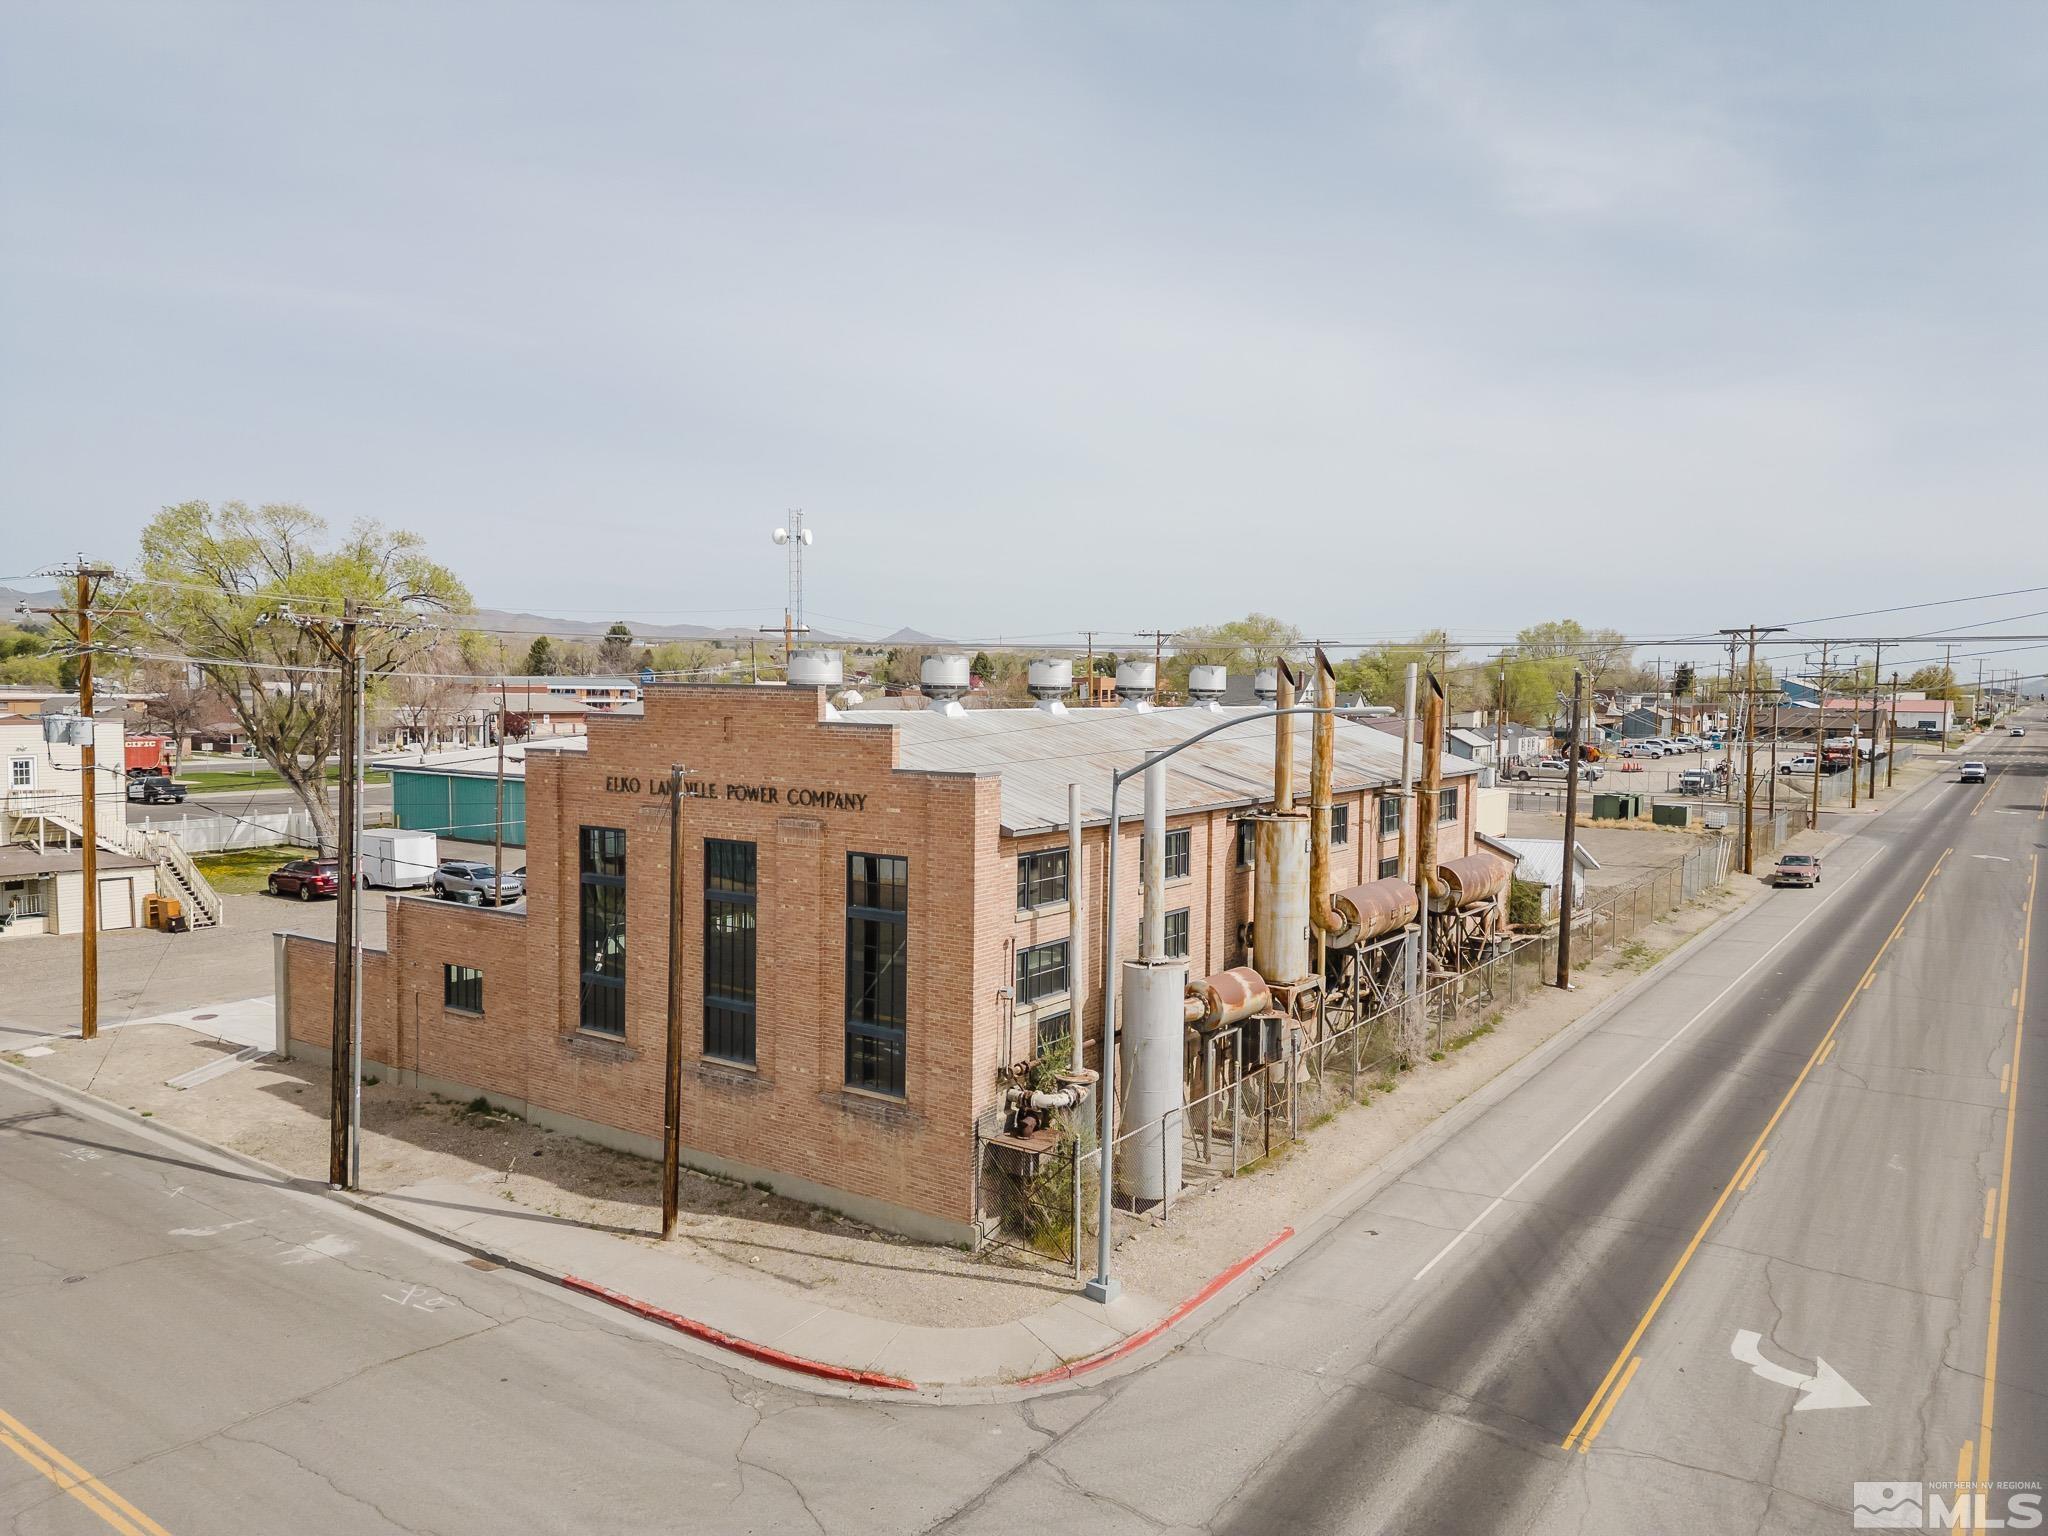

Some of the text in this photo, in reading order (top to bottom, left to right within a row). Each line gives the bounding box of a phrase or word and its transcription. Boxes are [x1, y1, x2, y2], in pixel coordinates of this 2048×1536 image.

[606, 776, 641, 793] ELKO
[726, 784, 779, 803] POWER
[787, 788, 868, 811] COMPANY
